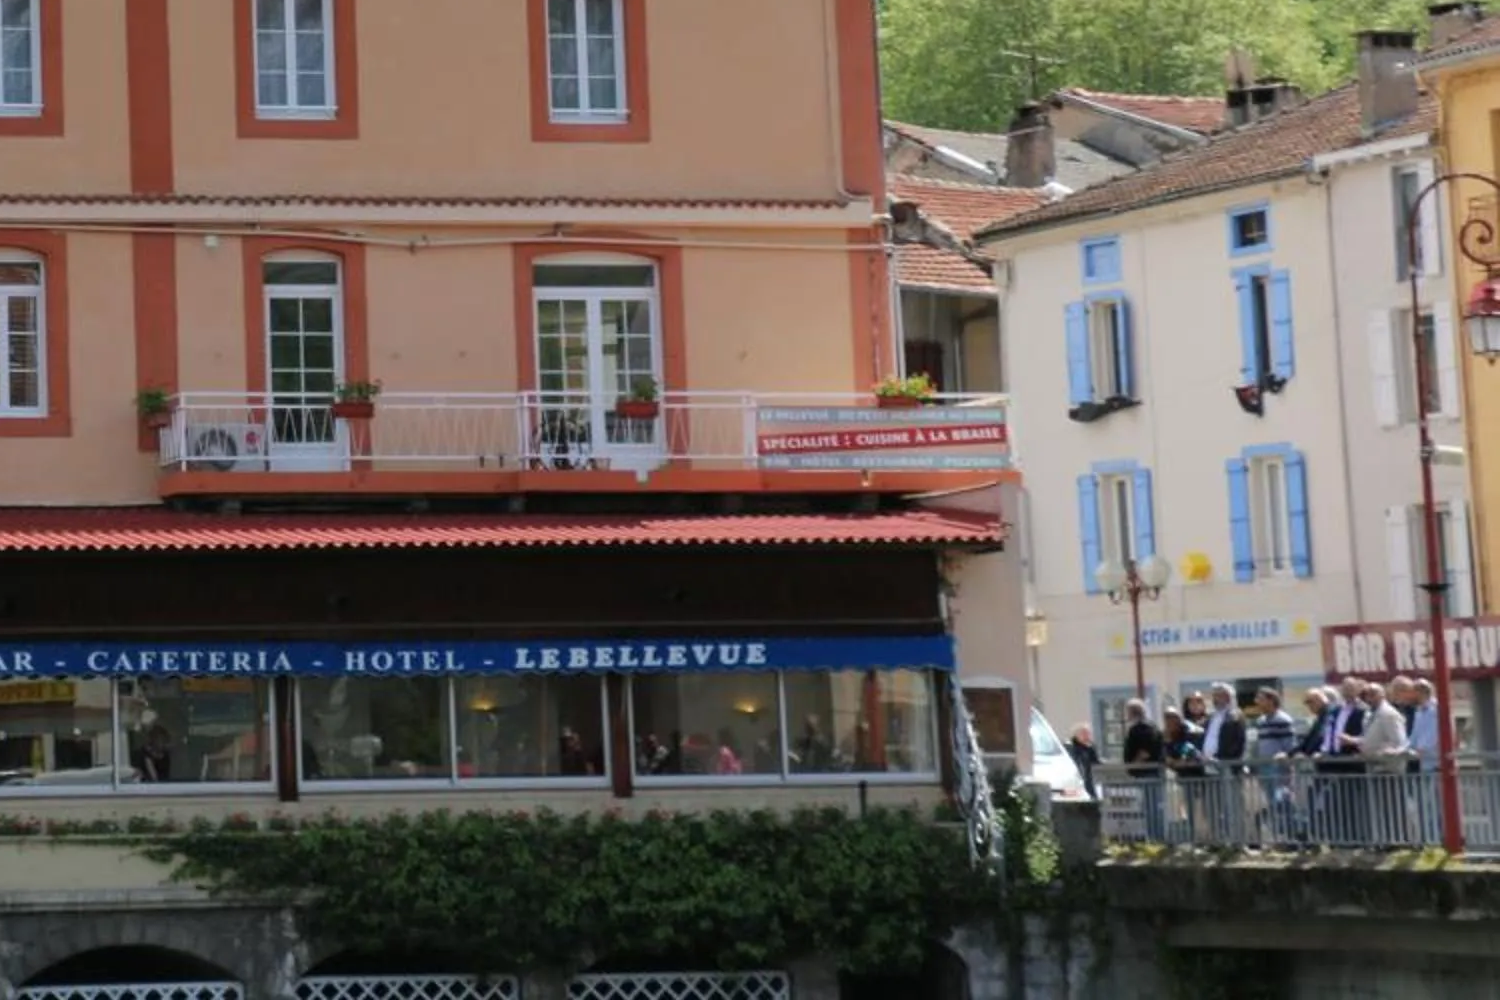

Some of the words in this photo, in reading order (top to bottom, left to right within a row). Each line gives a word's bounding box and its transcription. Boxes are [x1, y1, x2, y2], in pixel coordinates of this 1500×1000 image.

[855, 431, 910, 446] CUISINE
[930, 429, 947, 441] LA
[951, 427, 1000, 441] BRAISE
[1137, 627, 1181, 646] CTION
[1333, 631, 1388, 673] BAR
[1393, 624, 1500, 671] RETAU
[87, 651, 293, 672] CAFETERIA
[346, 651, 464, 671] HOTEL
